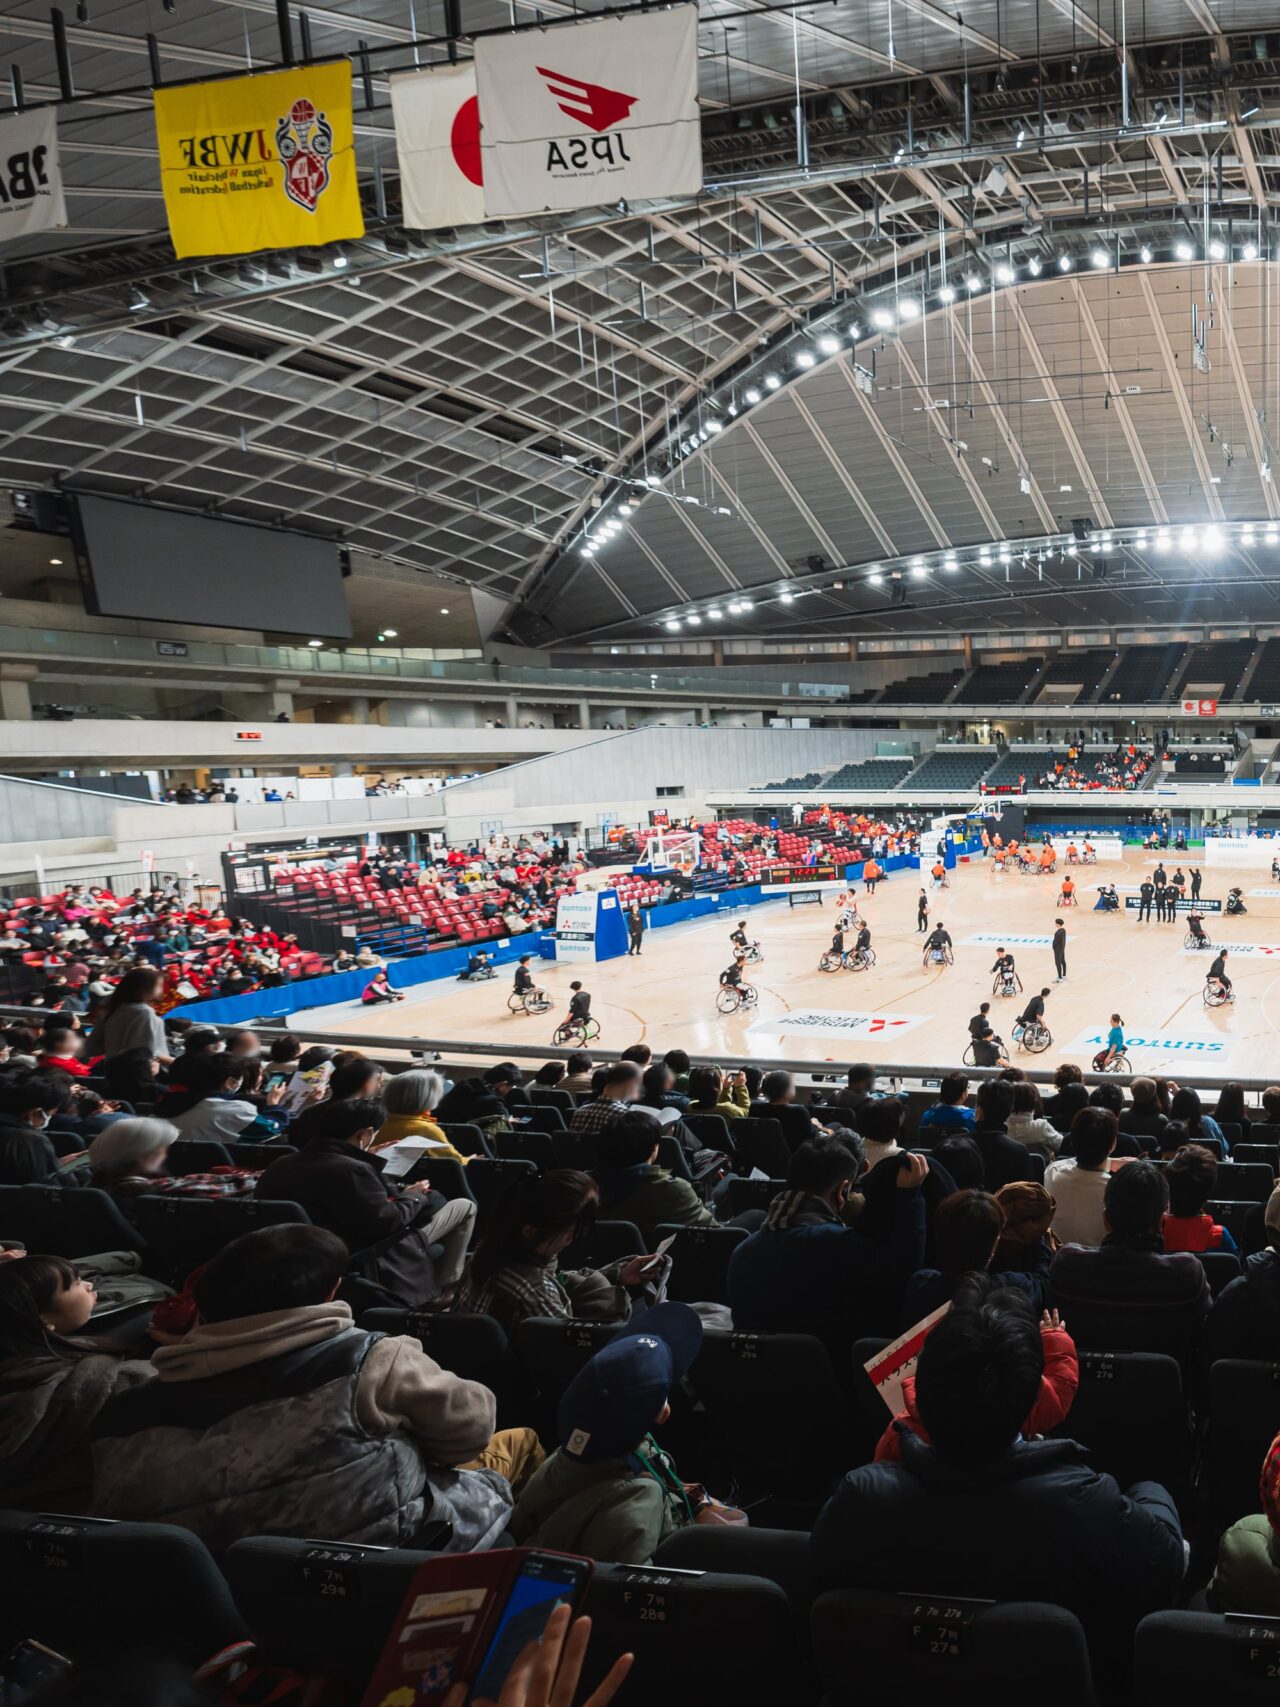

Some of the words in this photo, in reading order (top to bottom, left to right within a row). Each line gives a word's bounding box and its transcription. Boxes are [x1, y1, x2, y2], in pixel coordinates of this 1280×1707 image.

[1085, 1036, 1224, 1051] SUNTOY
[303, 1568, 311, 1579] F
[624, 1592, 632, 1603] F
[913, 1625, 921, 1637] F
[1250, 1649, 1259, 1660] F
